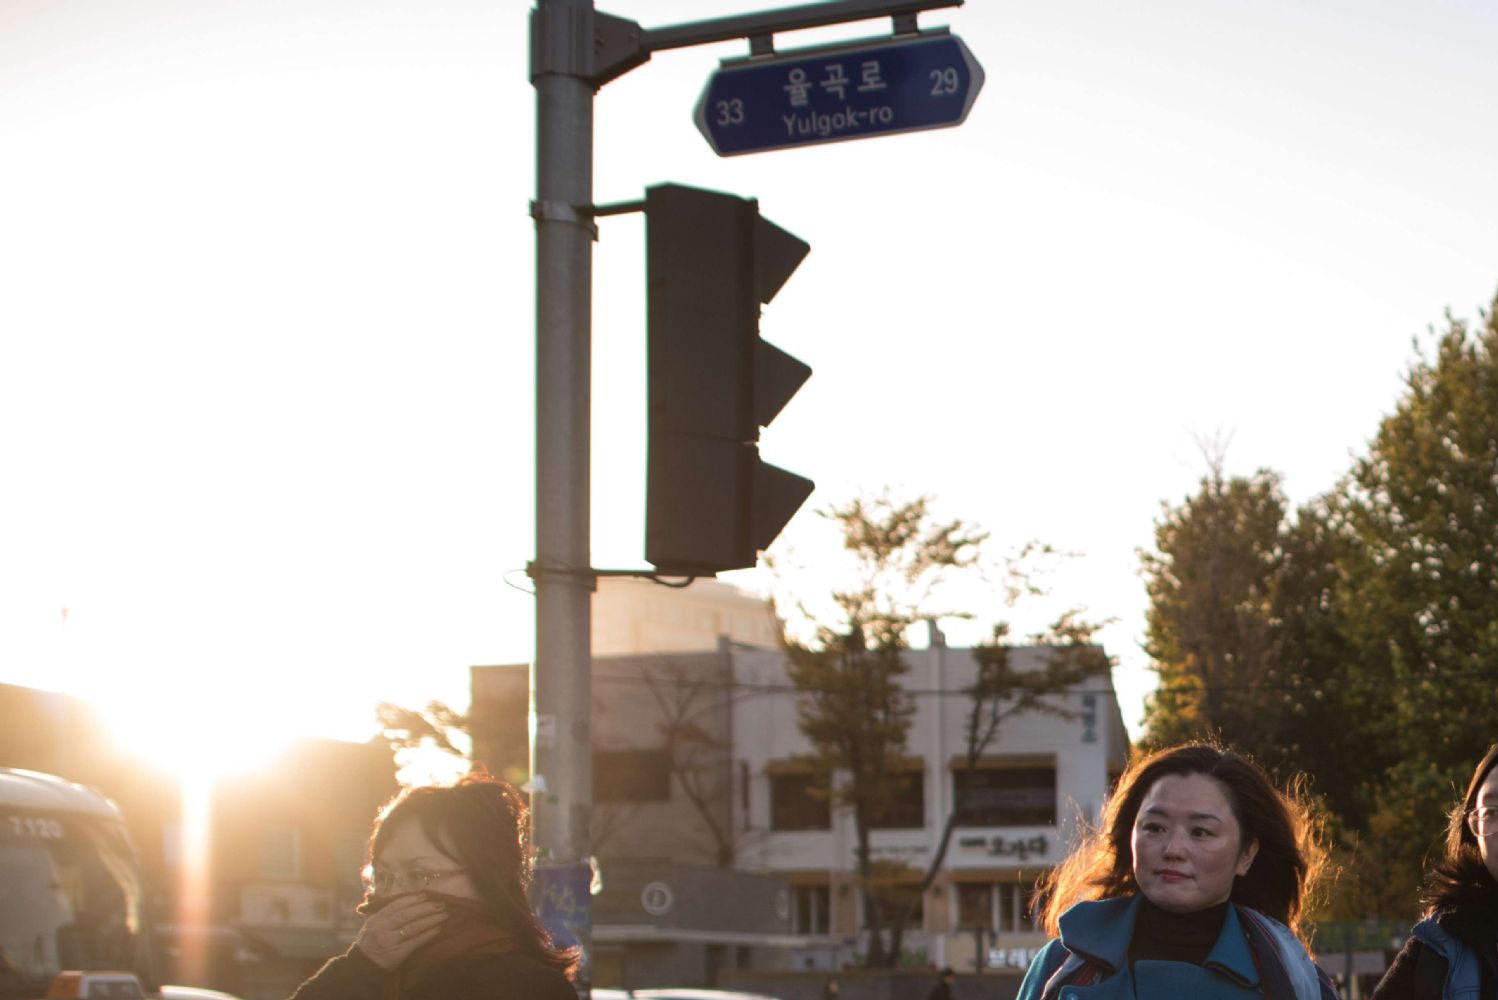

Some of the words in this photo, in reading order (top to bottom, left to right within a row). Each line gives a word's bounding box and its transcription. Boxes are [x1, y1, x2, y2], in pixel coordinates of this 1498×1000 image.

[783, 60, 887, 106] 율곡로
[929, 68, 959, 96] 29
[716, 99, 745, 127] 33
[783, 104, 894, 137] Yulgok-ro
